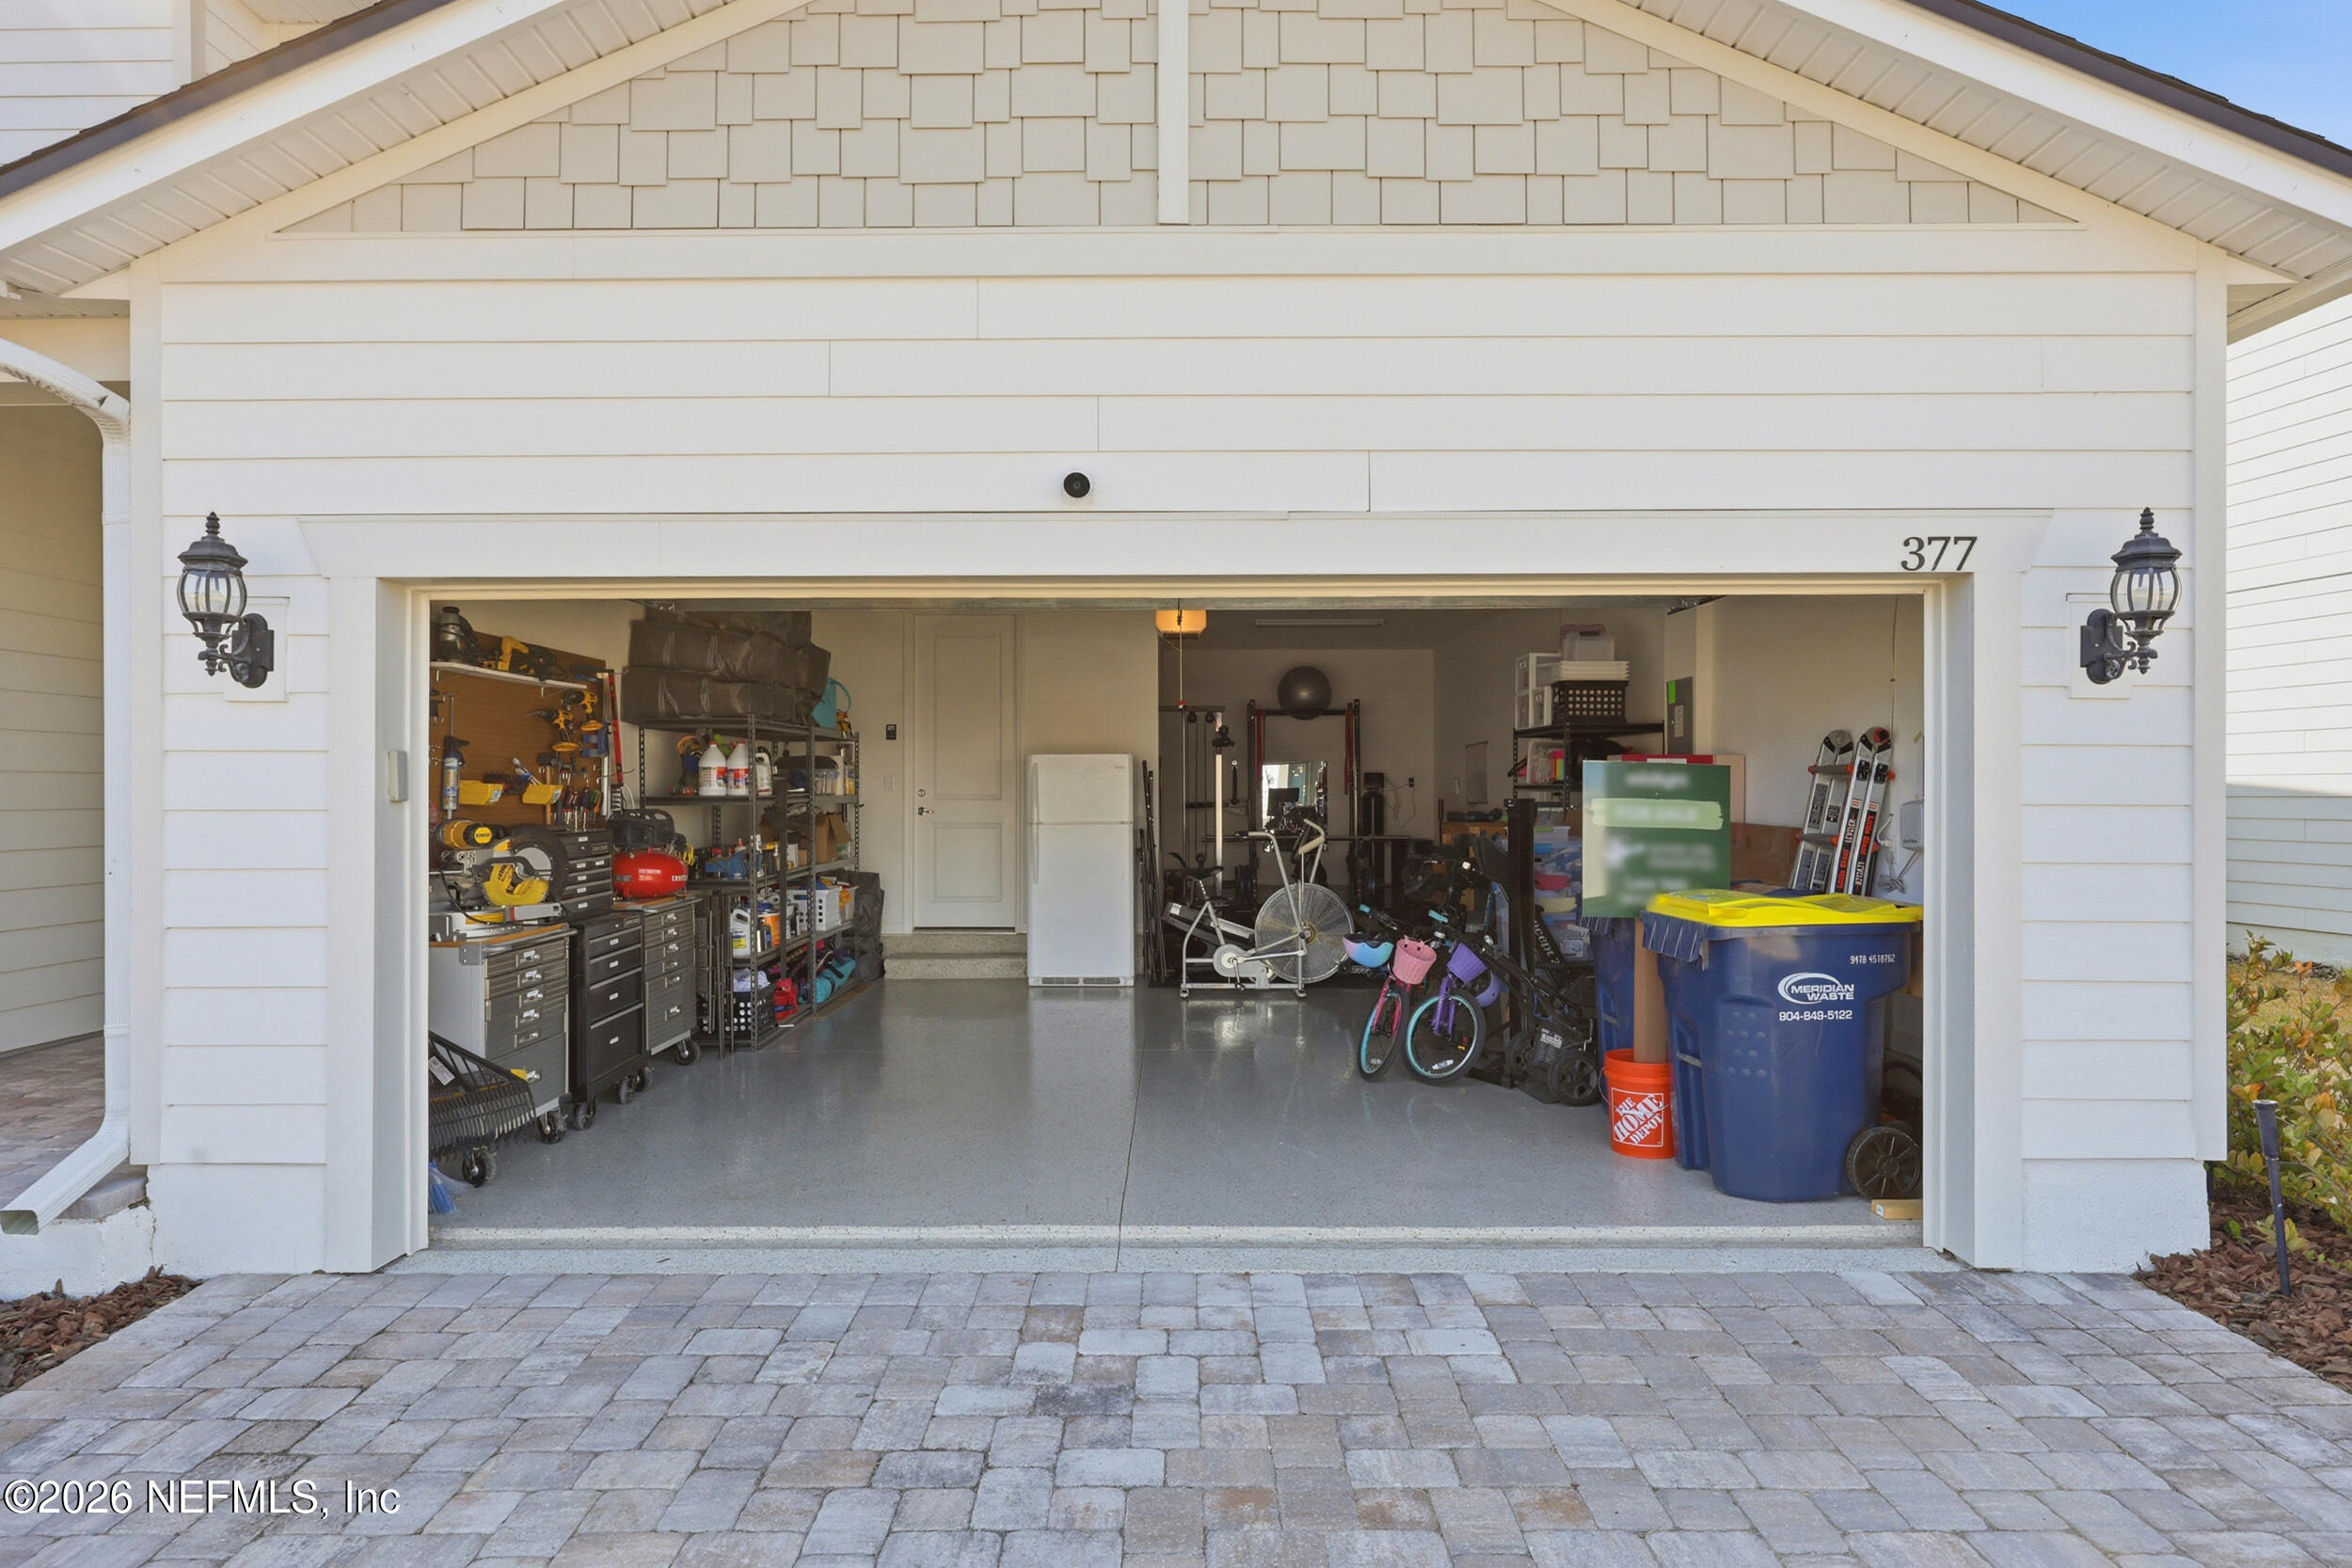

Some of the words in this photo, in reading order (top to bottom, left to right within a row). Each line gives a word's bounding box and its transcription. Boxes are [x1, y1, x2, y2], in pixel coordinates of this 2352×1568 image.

[1900, 536, 1978, 571] 377
[1790, 984, 1854, 994] MERIDIAN
[1806, 992, 1854, 1001] WASTE
[1778, 1009, 1852, 1022] 904-849-5122
[1615, 1097, 1636, 1117] THE
[1613, 1094, 1663, 1142] HOME
[1629, 1113, 1663, 1145] DEPOT
